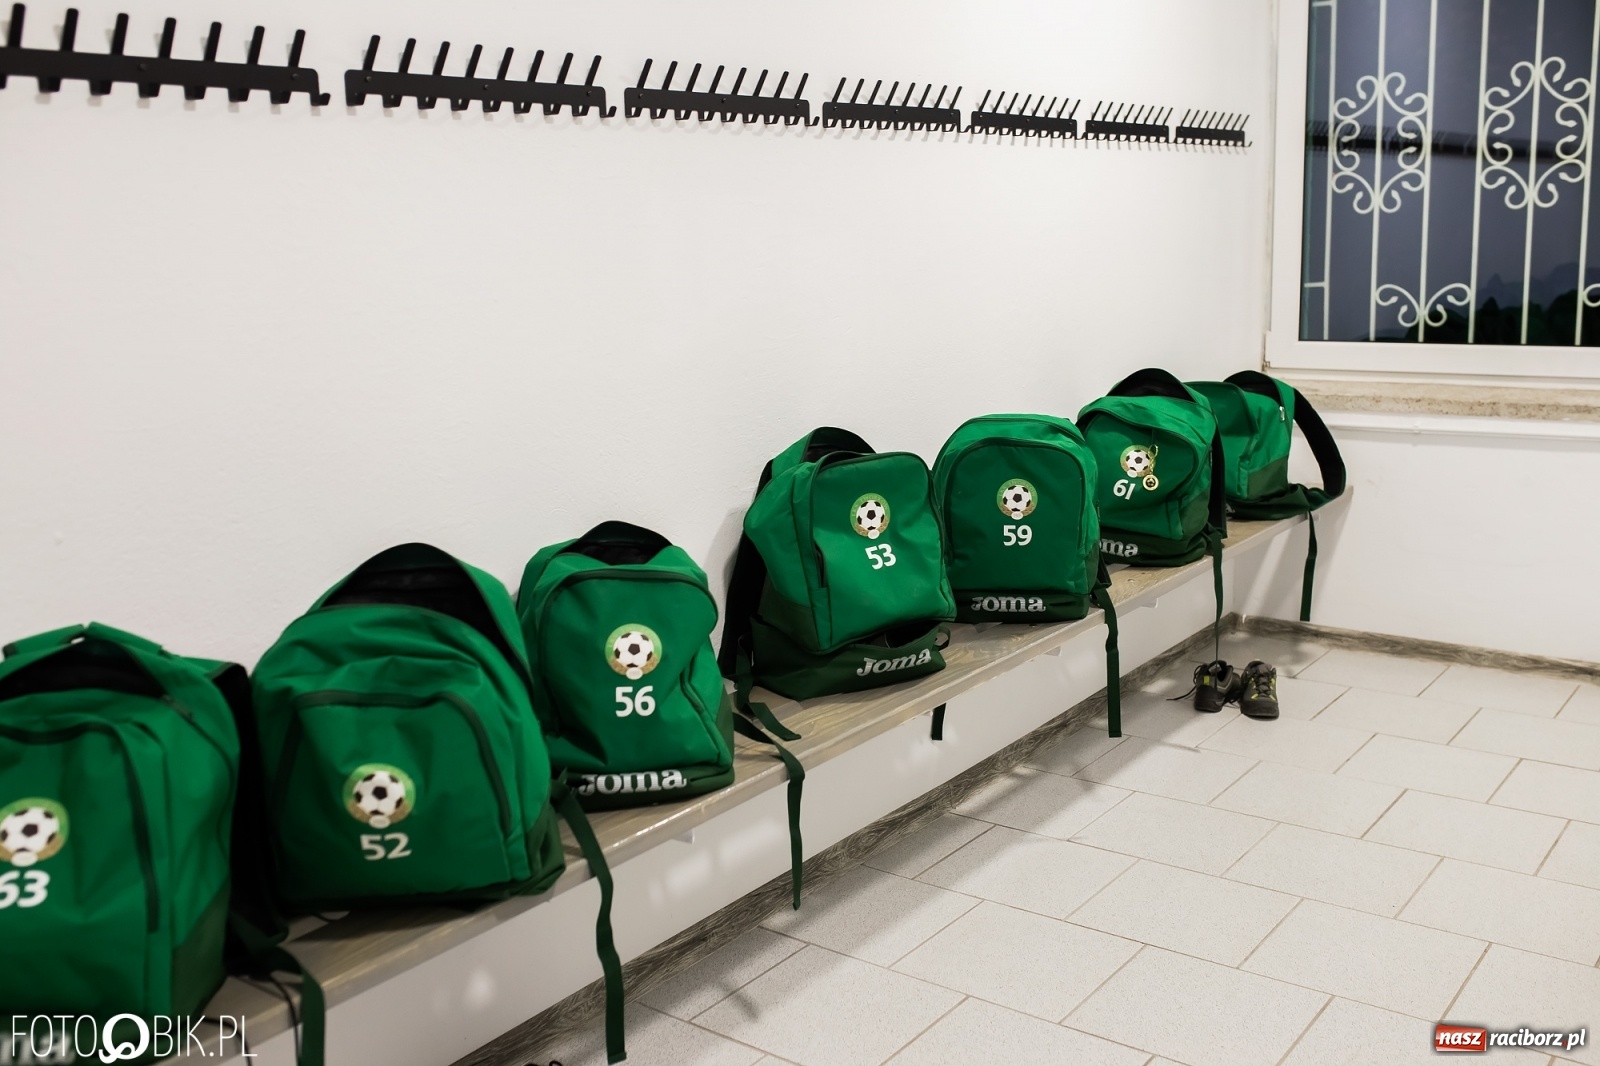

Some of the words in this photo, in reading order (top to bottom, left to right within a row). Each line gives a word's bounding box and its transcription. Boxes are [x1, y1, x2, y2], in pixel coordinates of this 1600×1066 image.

[1113, 479, 1136, 500] 61
[1003, 524, 1033, 546] 59
[1100, 538, 1139, 557] ma
[865, 543, 897, 570] 53
[857, 648, 932, 677] Joma
[615, 685, 656, 718] 56
[360, 832, 412, 861] 52
[0, 869, 51, 909] 63
